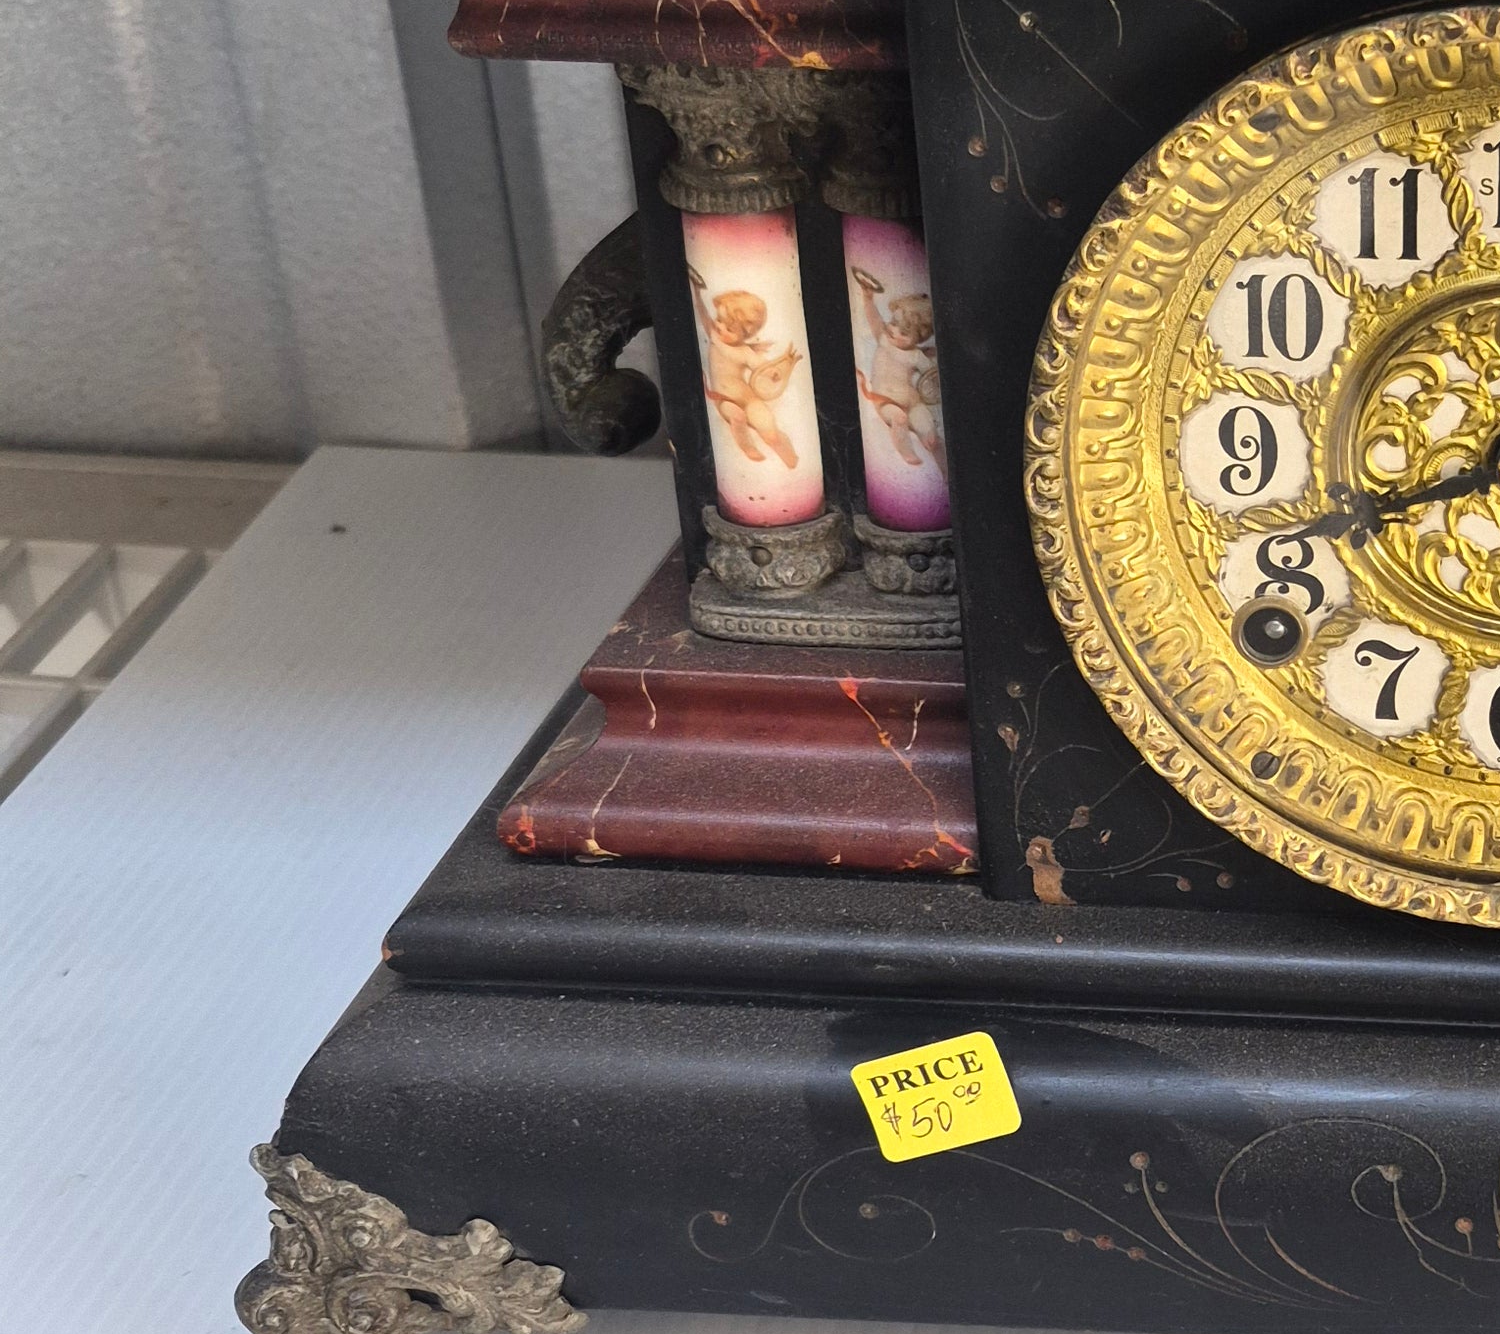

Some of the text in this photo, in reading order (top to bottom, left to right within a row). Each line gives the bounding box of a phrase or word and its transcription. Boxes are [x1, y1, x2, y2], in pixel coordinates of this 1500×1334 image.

[1347, 167, 1424, 261] 11
[1235, 273, 1324, 362] 10
[1217, 405, 1280, 497] 9
[1254, 533, 1325, 617] 8
[1353, 638, 1421, 721] 7
[866, 1049, 984, 1099] PRICE
